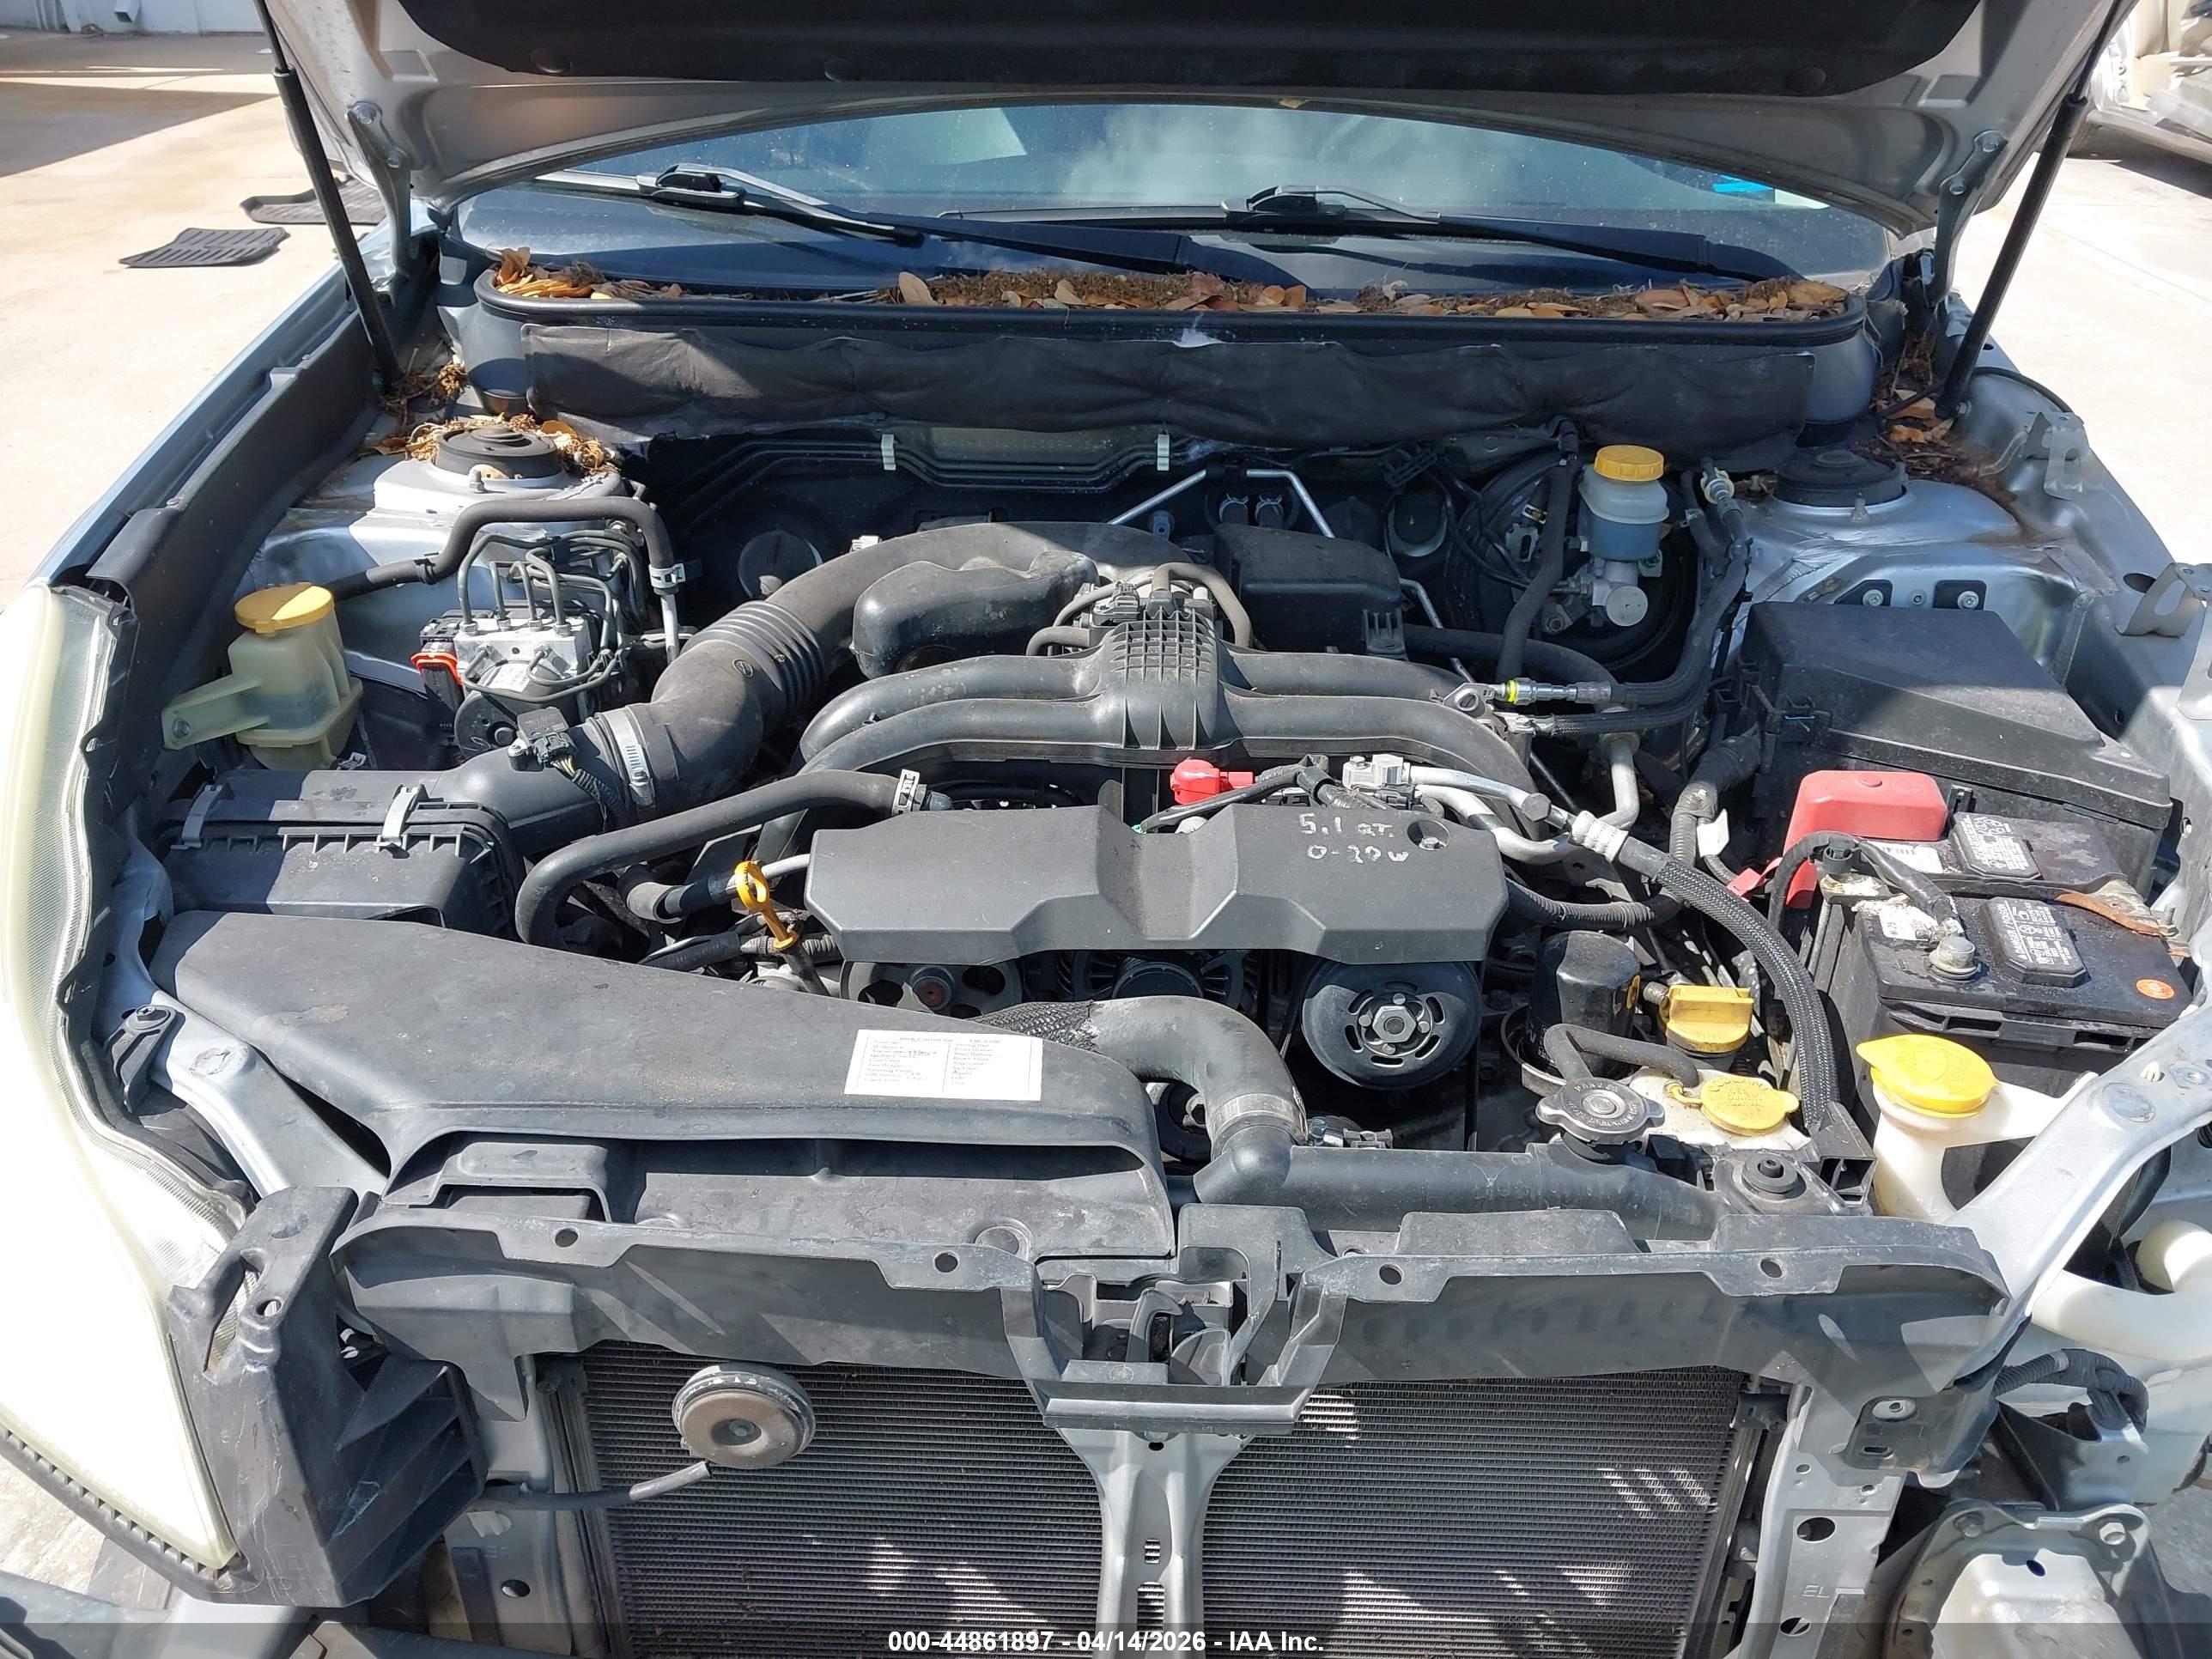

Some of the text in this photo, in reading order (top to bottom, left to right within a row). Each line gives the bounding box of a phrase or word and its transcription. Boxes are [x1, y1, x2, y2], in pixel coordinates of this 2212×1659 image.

[1298, 811, 1342, 835] 5.1
[1996, 902, 2014, 925] POISON
[2007, 929, 2026, 954] DANGER
